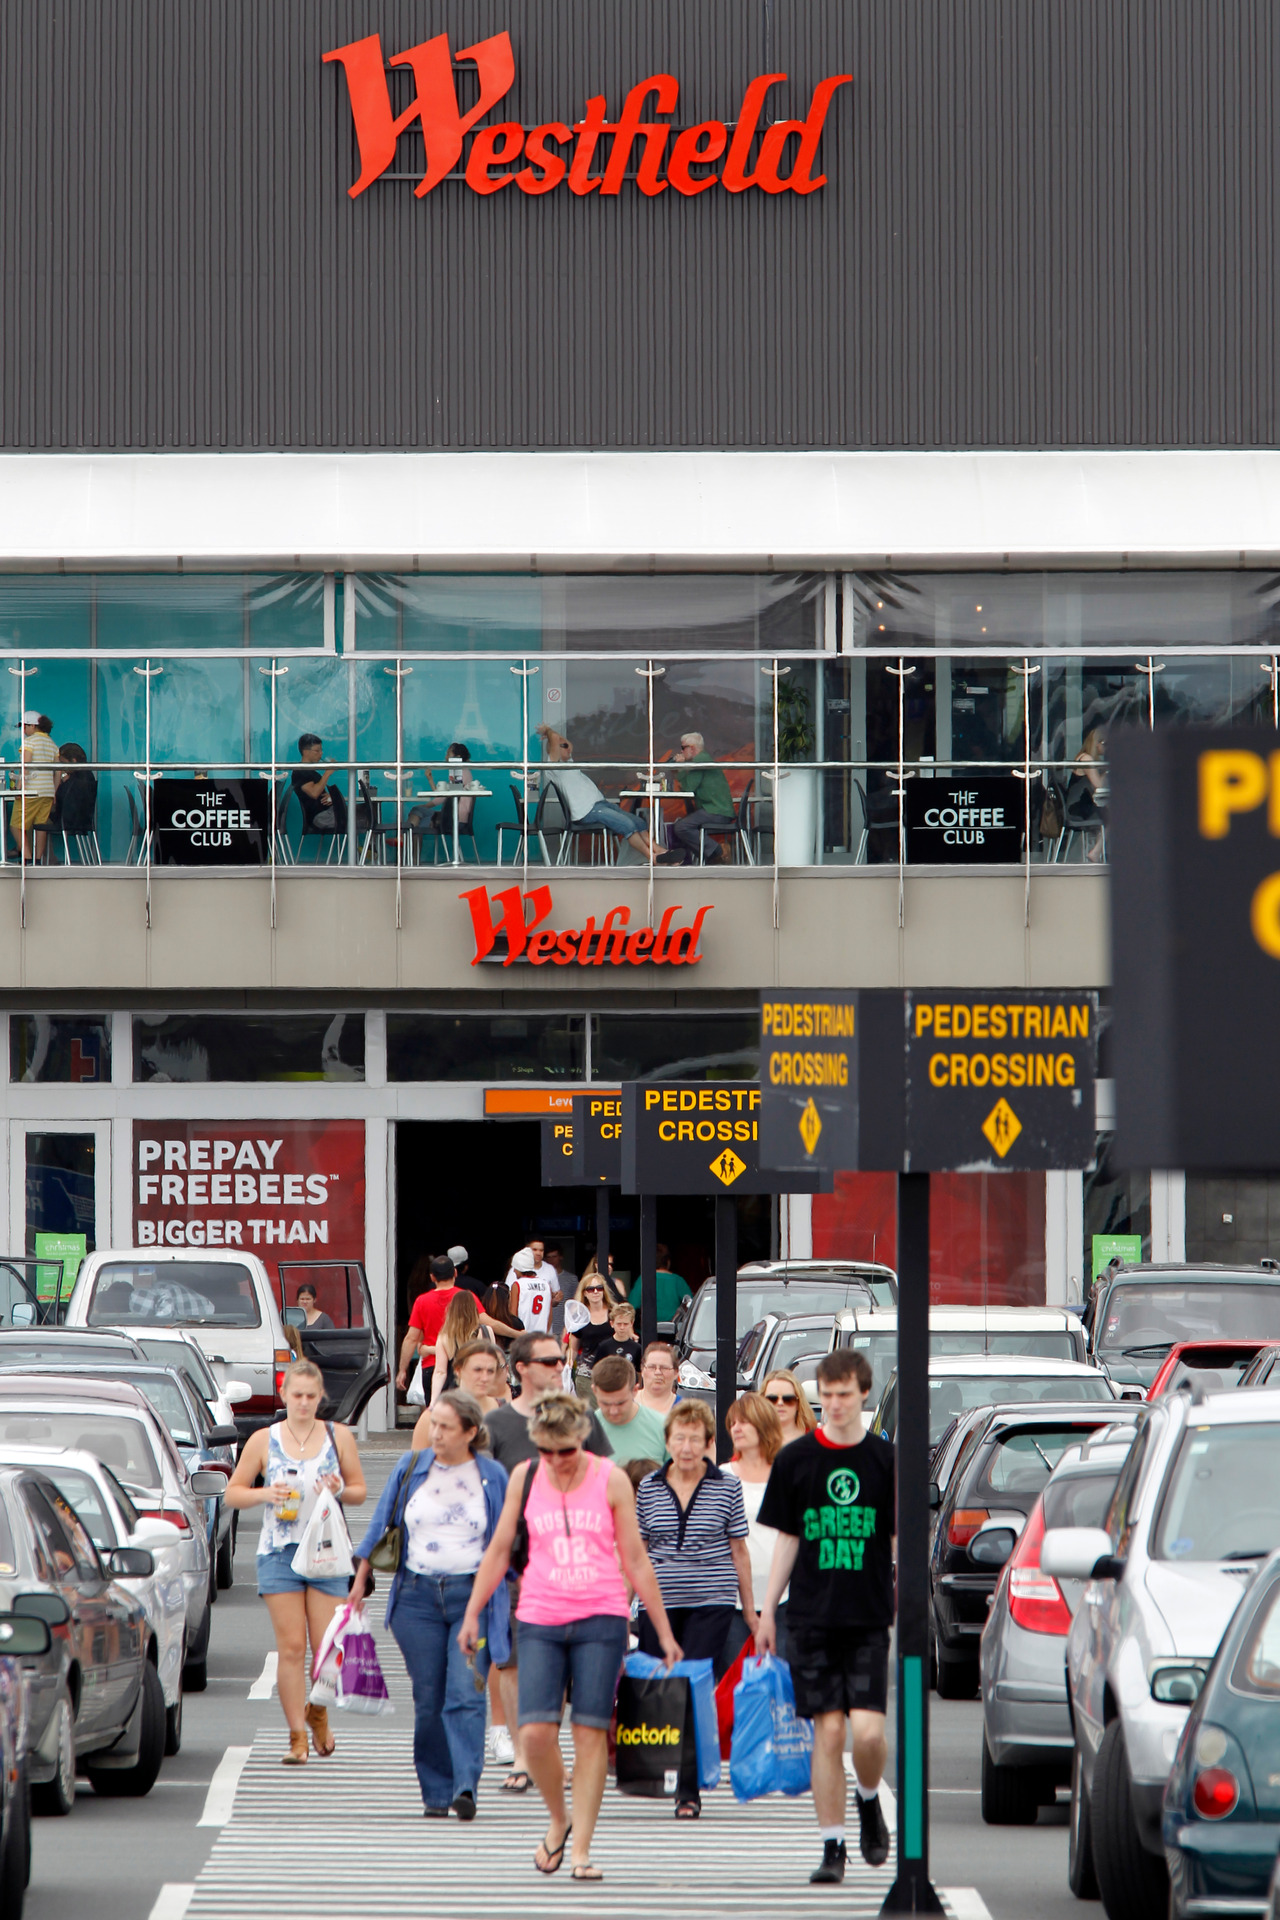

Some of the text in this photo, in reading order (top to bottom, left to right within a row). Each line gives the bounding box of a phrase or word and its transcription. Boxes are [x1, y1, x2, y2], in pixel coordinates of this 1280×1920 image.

[322, 31, 853, 199] Westfield
[196, 792, 226, 807] THE
[948, 791, 979, 806] THE
[171, 809, 251, 828] COFFEE
[924, 808, 1005, 827] COFFEE
[190, 831, 232, 847] CLUB
[943, 830, 985, 845] CLUB
[458, 885, 715, 967] Westfield
[762, 1003, 854, 1037] PEDESTRIAN
[915, 1004, 1089, 1038] PEDESTRIAN
[769, 1052, 848, 1087] CROSSING
[929, 1053, 1076, 1088] CROSSING
[658, 1120, 758, 1142] CROSSI
[139, 1139, 284, 1171] PREPAY
[138, 1219, 329, 1245] BIGGER THAN
[45, 1241, 80, 1252] christmas
[1101, 1242, 1136, 1253] christmas
[527, 1283, 546, 1292] JAMES
[532, 1295, 544, 1315] 6
[533, 1510, 602, 1537] RUSSELL
[803, 1505, 877, 1541] GREEN
[553, 1536, 588, 1566] 02
[819, 1538, 866, 1571] DAY
[616, 1722, 681, 1745] factorie
